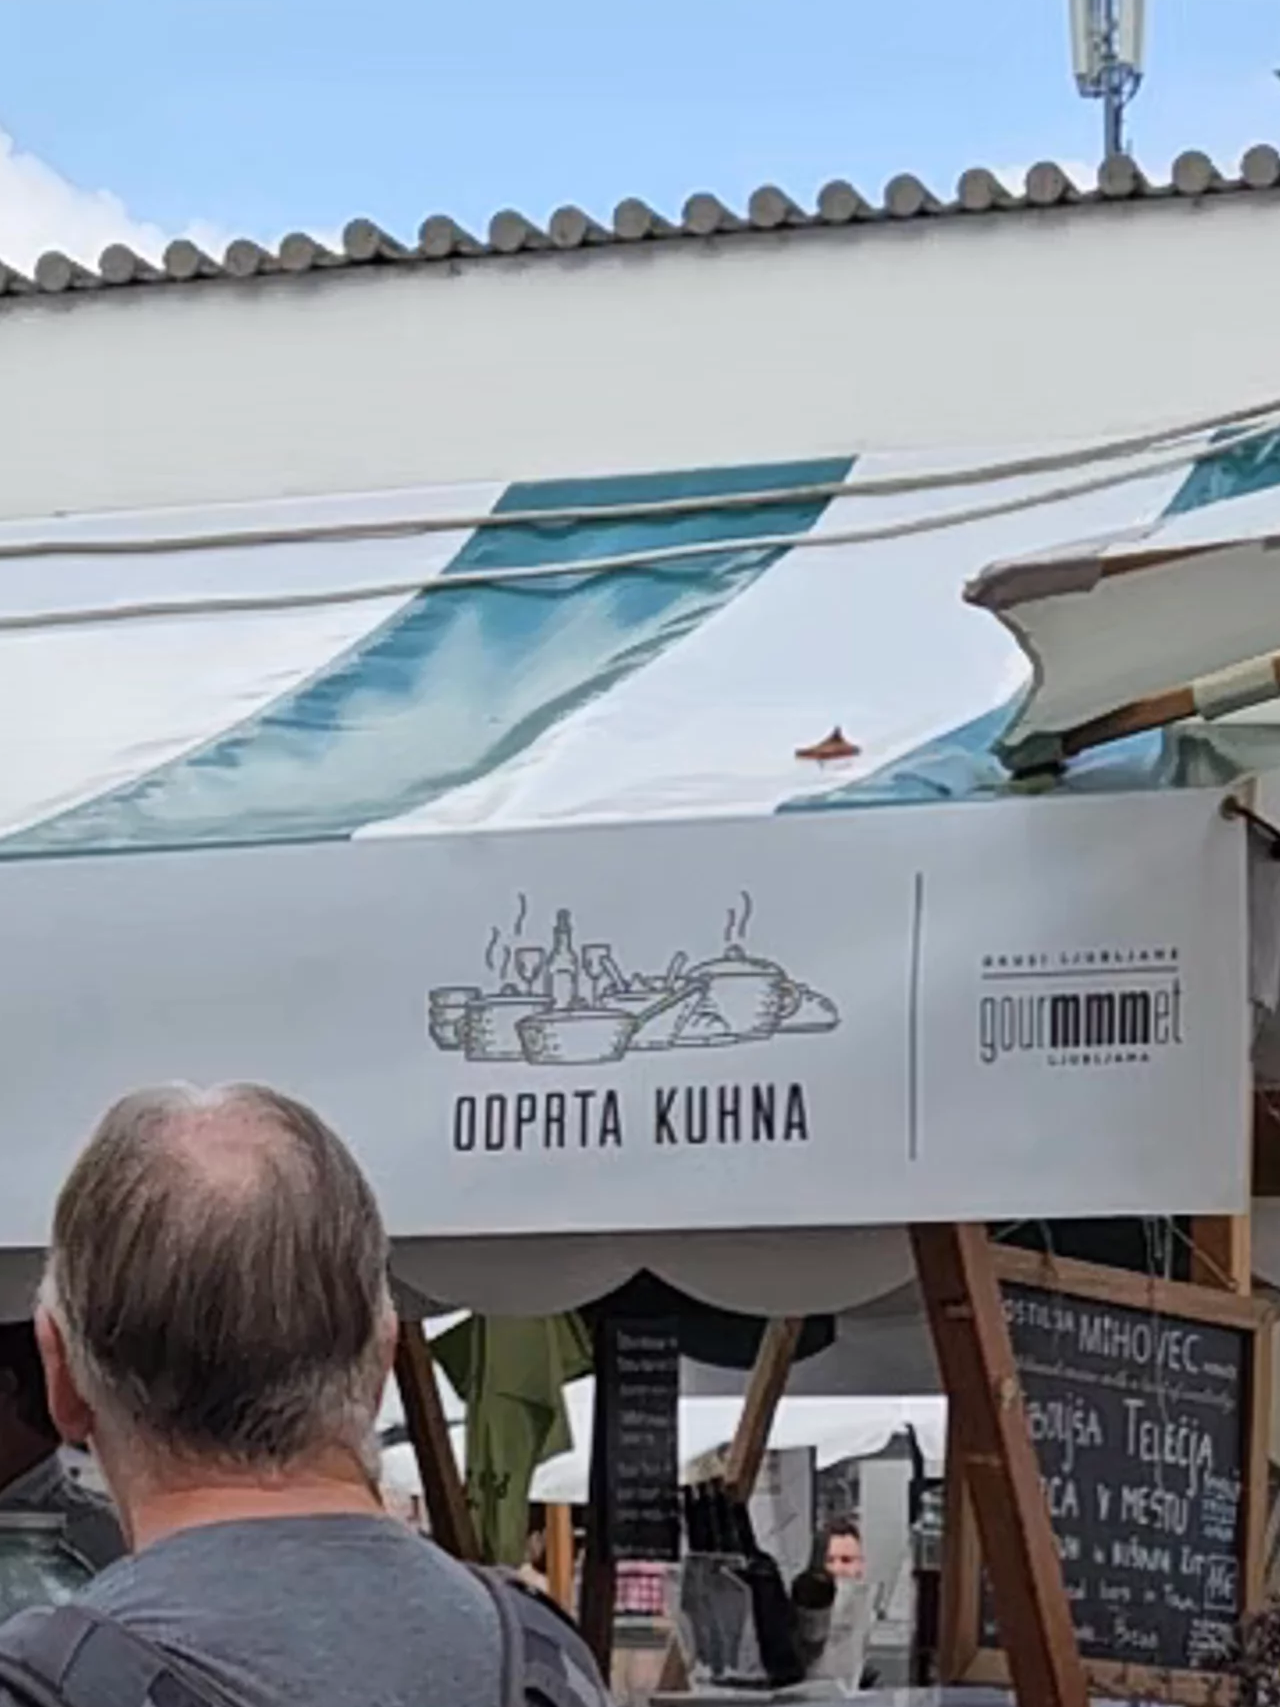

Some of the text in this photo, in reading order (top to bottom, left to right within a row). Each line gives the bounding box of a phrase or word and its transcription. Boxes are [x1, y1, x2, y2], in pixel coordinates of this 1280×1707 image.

[980, 977, 1183, 1064] gourmmmet
[453, 1082, 809, 1151] ODPRTA KUHNA
